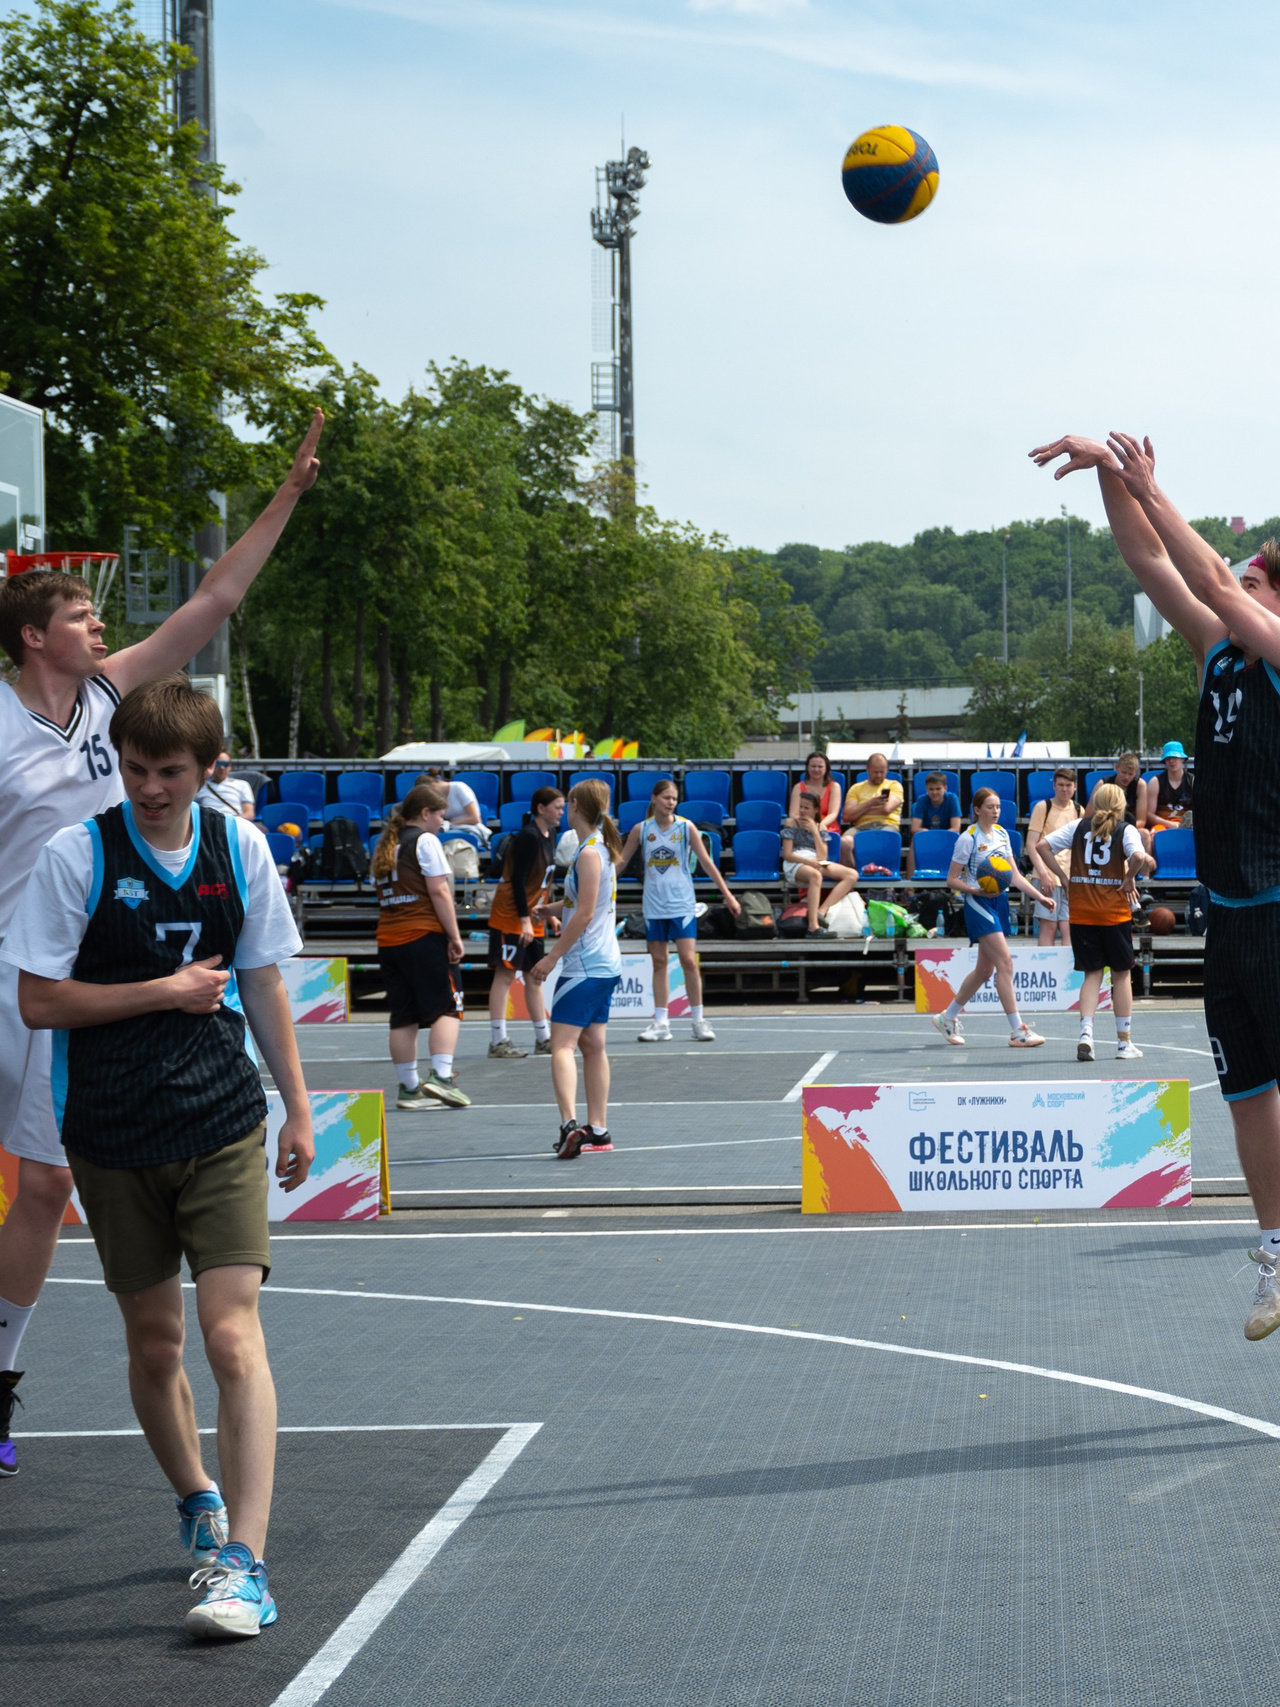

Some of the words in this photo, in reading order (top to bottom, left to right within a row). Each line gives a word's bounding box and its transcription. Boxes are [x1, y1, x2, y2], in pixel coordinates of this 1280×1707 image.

[79, 733, 113, 781] 15
[669, 832, 683, 843] 44
[1083, 831, 1112, 866] 13
[155, 922, 202, 970] 7
[501, 944, 517, 962] 17
[1024, 990, 1057, 1002] СПОРТА
[957, 1096, 967, 1106] ОК
[969, 1096, 1007, 1106] «ЛУЖНИКИ»
[1047, 1091, 1086, 1100] МОСКОВСКИЙ
[1047, 1100, 1065, 1108] СПОРТ
[909, 1129, 1084, 1165] ФЕСТИВАЛЬ
[909, 1169, 1012, 1191] ШКОЛЬНОГО
[1018, 1167, 1084, 1190] СПОРТА
